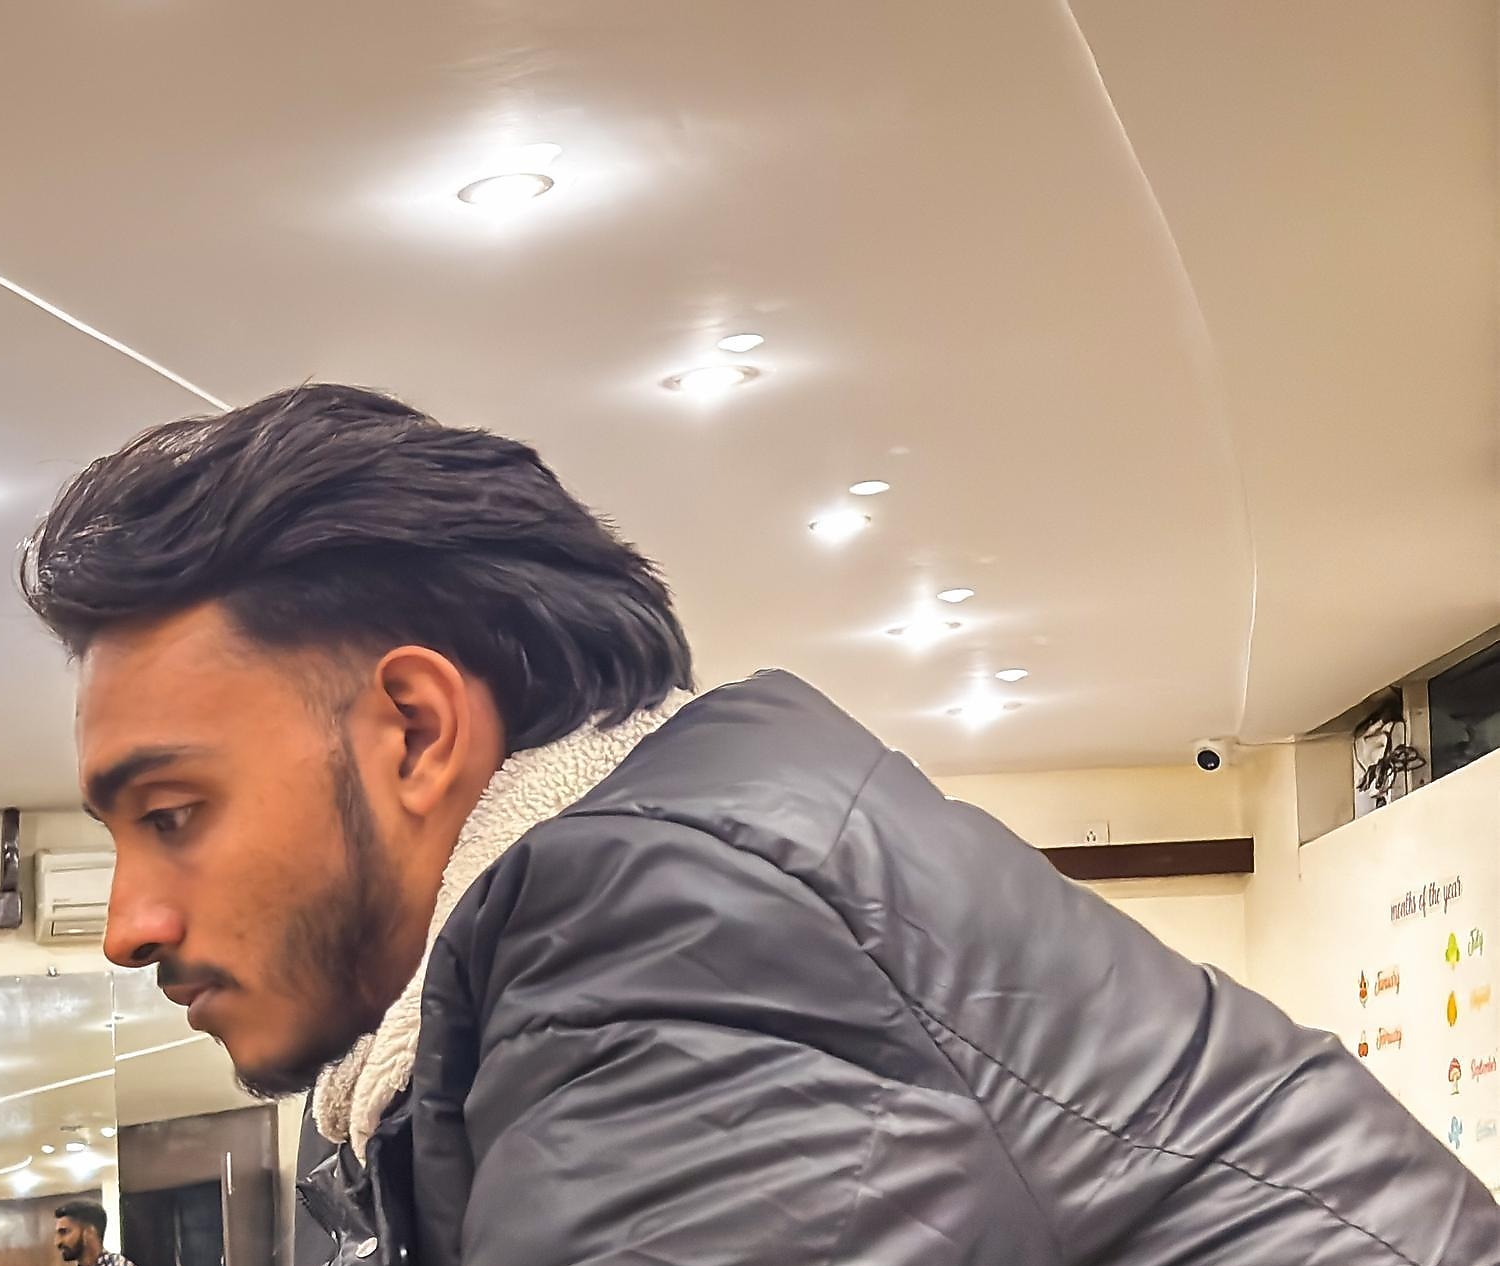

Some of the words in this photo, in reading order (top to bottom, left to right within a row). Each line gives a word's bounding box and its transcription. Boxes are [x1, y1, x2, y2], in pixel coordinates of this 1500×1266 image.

[1390, 890, 1416, 921] months
[1419, 884, 1427, 918] of
[1428, 881, 1441, 907] the
[1443, 875, 1462, 915] year
